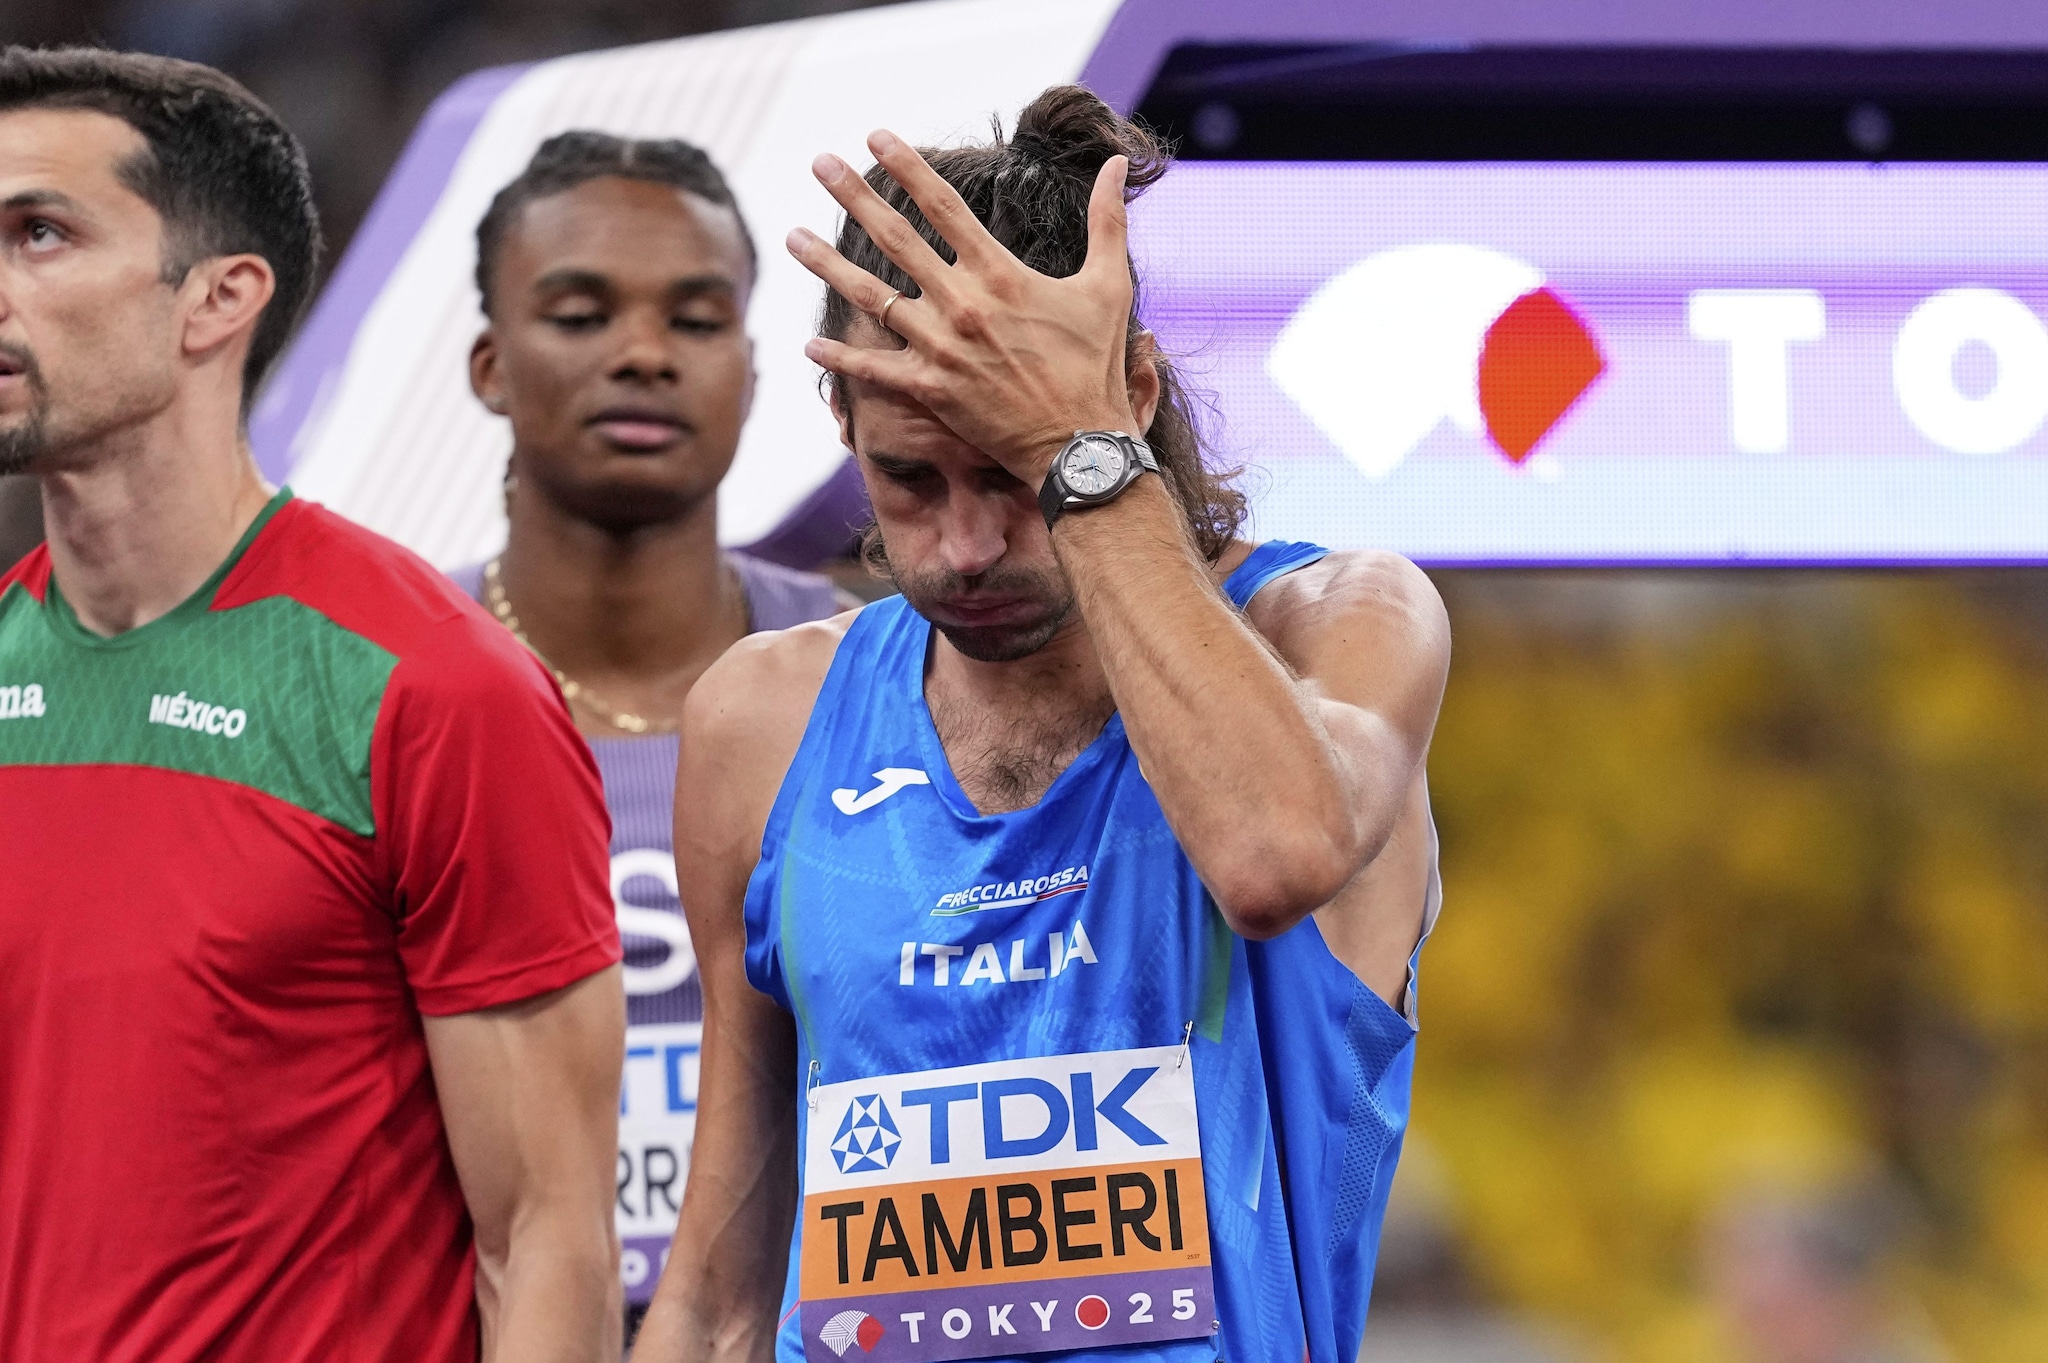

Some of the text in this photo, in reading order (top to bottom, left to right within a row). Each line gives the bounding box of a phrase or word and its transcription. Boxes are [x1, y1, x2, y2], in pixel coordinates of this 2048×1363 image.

[1686, 286, 2048, 456] TO
[149, 690, 247, 738] MÉXICO
[935, 865, 1089, 907] FRECCIAROSSA
[899, 919, 1098, 986] ITALIA
[901, 1066, 1168, 1165] TDK
[820, 1169, 1184, 1285] TAMBERI
[1128, 1288, 1198, 1322] 25
